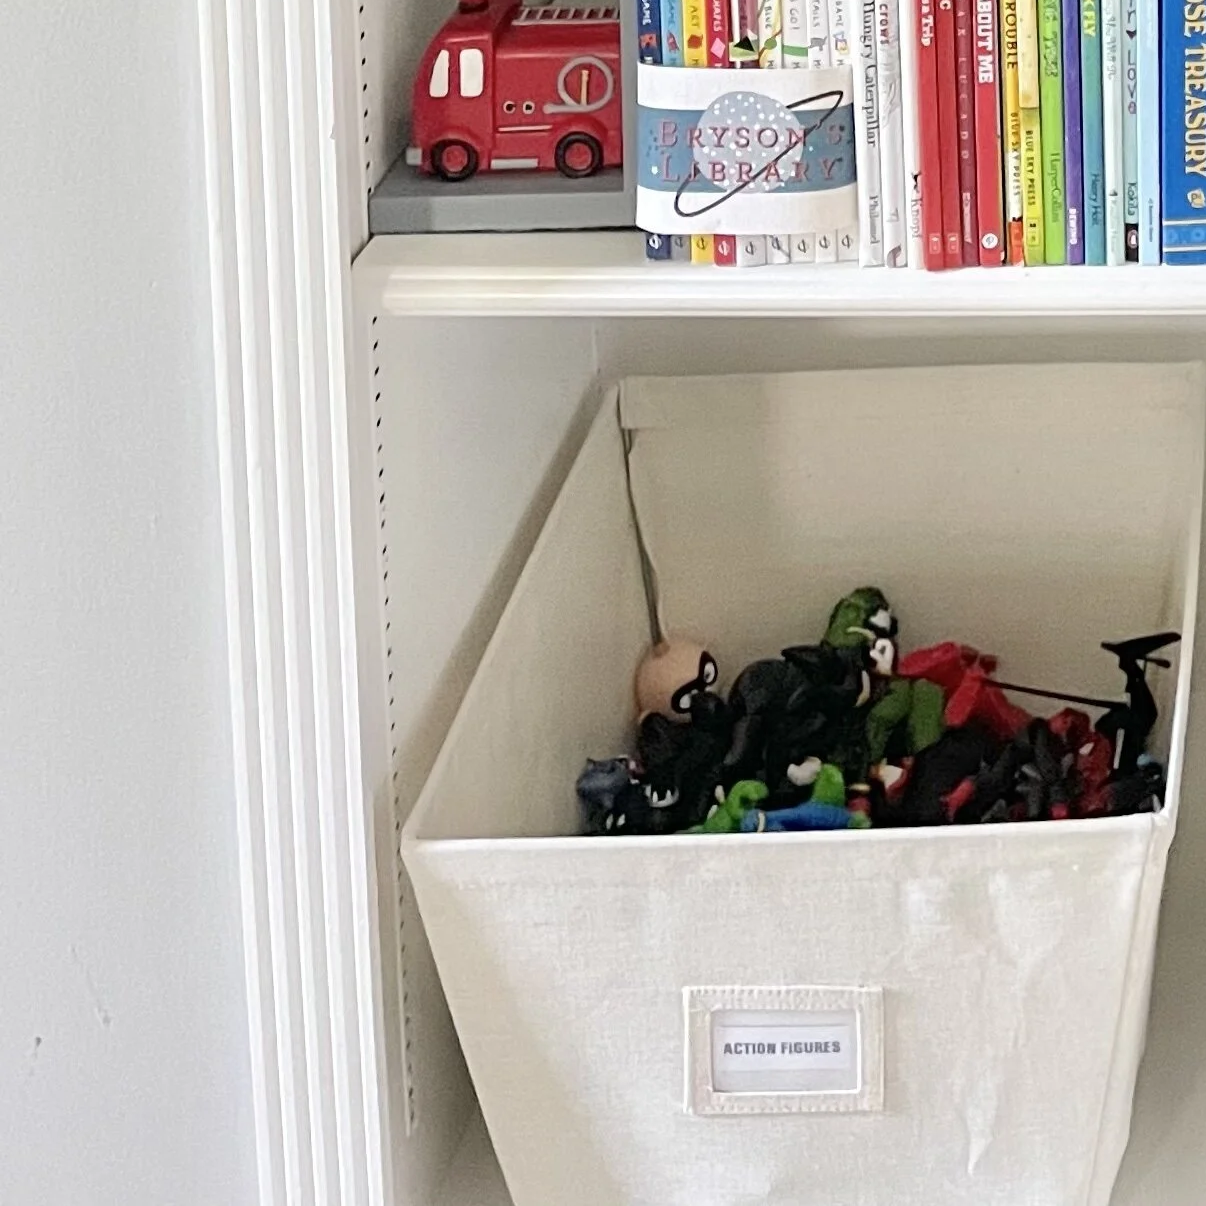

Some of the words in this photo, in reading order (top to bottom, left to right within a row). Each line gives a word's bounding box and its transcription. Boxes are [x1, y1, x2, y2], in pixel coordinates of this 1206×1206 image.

[788, 7, 799, 31] GO!
[859, 2, 875, 60] Hungry
[919, 14, 933, 47] Trip
[1083, 11, 1098, 38] FLY
[978, 54, 994, 83] ME
[861, 64, 878, 148] Caterpillar
[723, 1041, 777, 1057] ACTION
[781, 1040, 842, 1056] FIGURES
